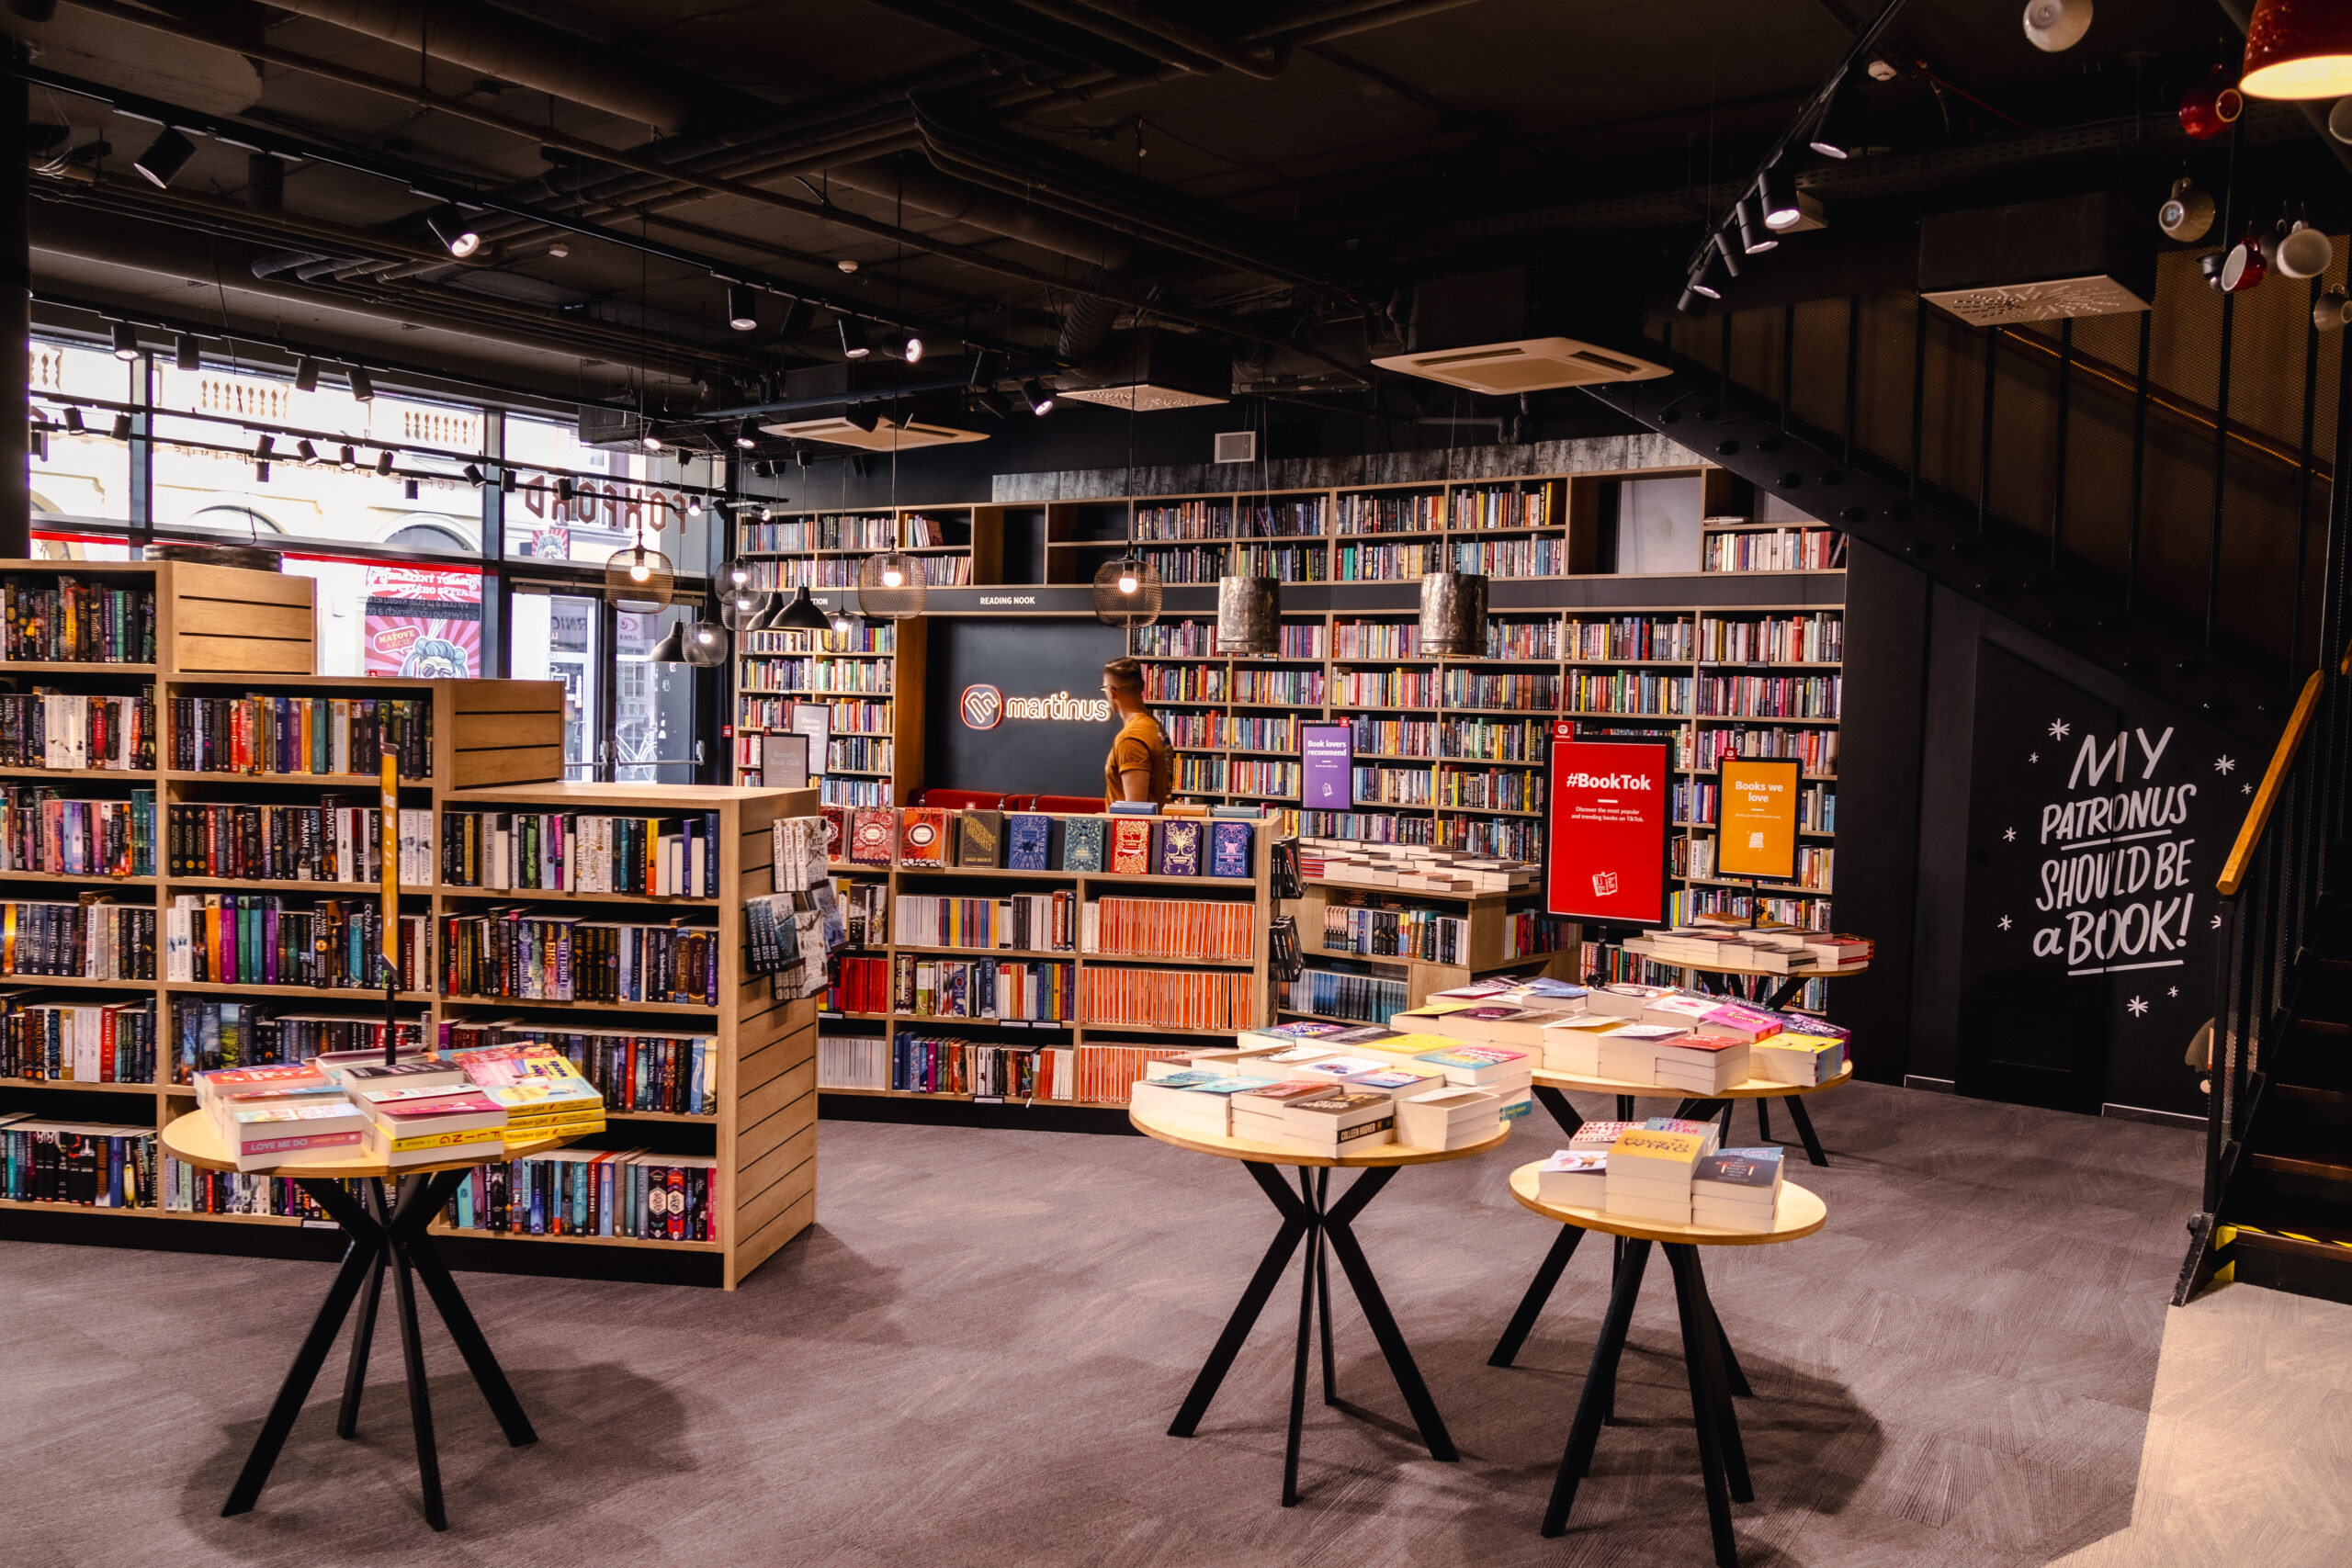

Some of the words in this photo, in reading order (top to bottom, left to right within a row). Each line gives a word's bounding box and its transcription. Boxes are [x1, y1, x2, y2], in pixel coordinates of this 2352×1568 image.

[979, 596, 1012, 604] READING
[1012, 596, 1035, 604] NOOK
[1006, 691, 1111, 722] martinus
[1307, 739, 1325, 748] Book
[1326, 739, 1347, 748] lovers
[1307, 749, 1347, 757] recommend
[2067, 726, 2175, 790] MY
[1566, 773, 1652, 791] #BookTok
[1735, 781, 1767, 791] Books
[1768, 784, 1784, 792] we
[1747, 792, 1770, 803] love
[310, 809, 318, 833] RYAN
[326, 807, 335, 841] TRAITOR
[1581, 813, 1602, 822] trending
[1620, 808, 1640, 817] popular
[2040, 783, 2198, 845] PATRONUS
[301, 819, 310, 847] PARIAH
[967, 827, 993, 852] HEIGHTS
[2034, 845, 2152, 912] SHOULD
[2153, 838, 2196, 891] BE
[364, 903, 373, 942] CONAN
[2031, 926, 2064, 958] a
[2064, 892, 2195, 966] BOOK!
[545, 942, 556, 967] FIRE
[559, 942, 569, 991] BITTERBLUE
[51, 1011, 60, 1060] GODSGRAVE
[438, 1130, 502, 1145] FLING
[1340, 1127, 1359, 1142] COLLEEN
[1359, 1122, 1376, 1137] HOOVER
[251, 1142, 276, 1153] LOVE
[277, 1139, 291, 1149] ME
[292, 1138, 308, 1148] DO
[1623, 1140, 1689, 1154] WING
